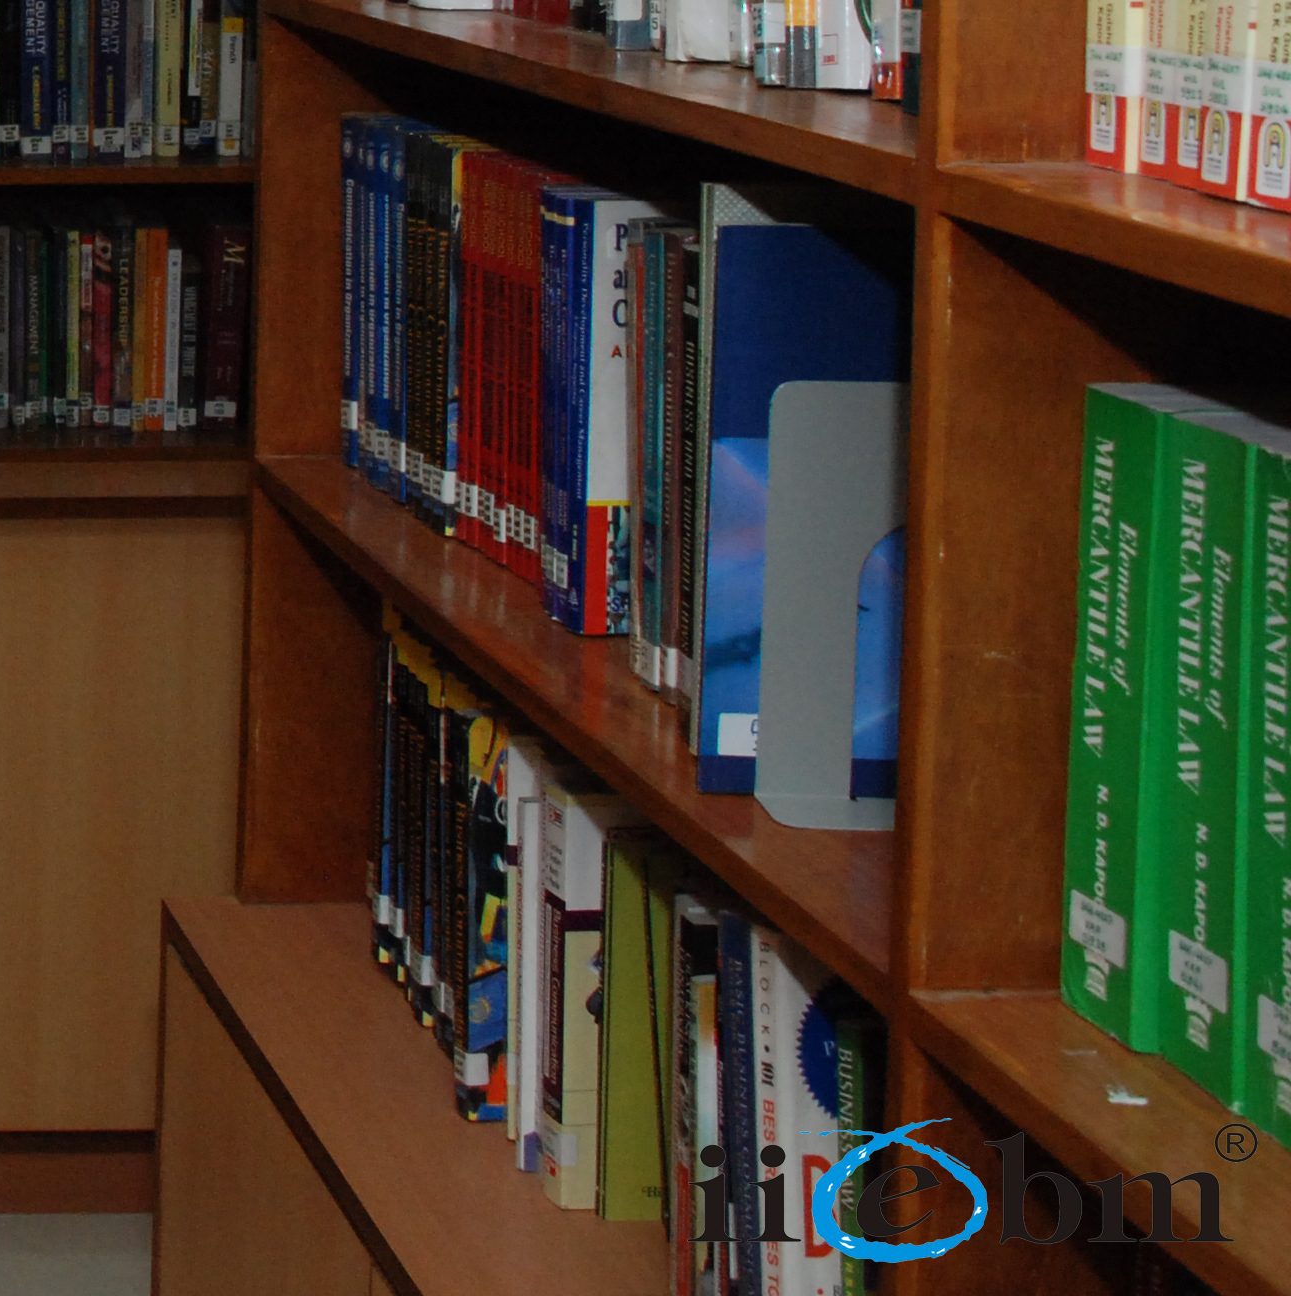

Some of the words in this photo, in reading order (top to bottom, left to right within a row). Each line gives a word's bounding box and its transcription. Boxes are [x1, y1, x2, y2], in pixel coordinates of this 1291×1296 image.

[576, 222, 590, 284] Personality
[28, 274, 39, 356] MANAGEMENT
[118, 258, 129, 345] LEADERSHIP
[577, 287, 589, 364] Development
[576, 386, 587, 424] Career
[577, 365, 587, 383] and
[681, 340, 697, 433] BUSINESS
[573, 427, 586, 501] Management
[681, 439, 694, 479] AND
[1085, 436, 1116, 665] MERCANTILE
[1113, 520, 1139, 648] Elements
[1177, 458, 1209, 705] MERCANTILE
[679, 598, 691, 654] LAWS
[1207, 544, 1235, 670] Elements
[1263, 493, 1289, 747] MERCANTILE
[1083, 665, 1107, 760] LAW
[1116, 654, 1133, 698] of
[1212, 677, 1230, 730] of
[1177, 704, 1202, 798] LAW
[1263, 752, 1286, 846] LAW
[549, 908, 563, 972] Business
[546, 976, 561, 1086] Communication
[839, 1048, 854, 1153] BUSINESS
